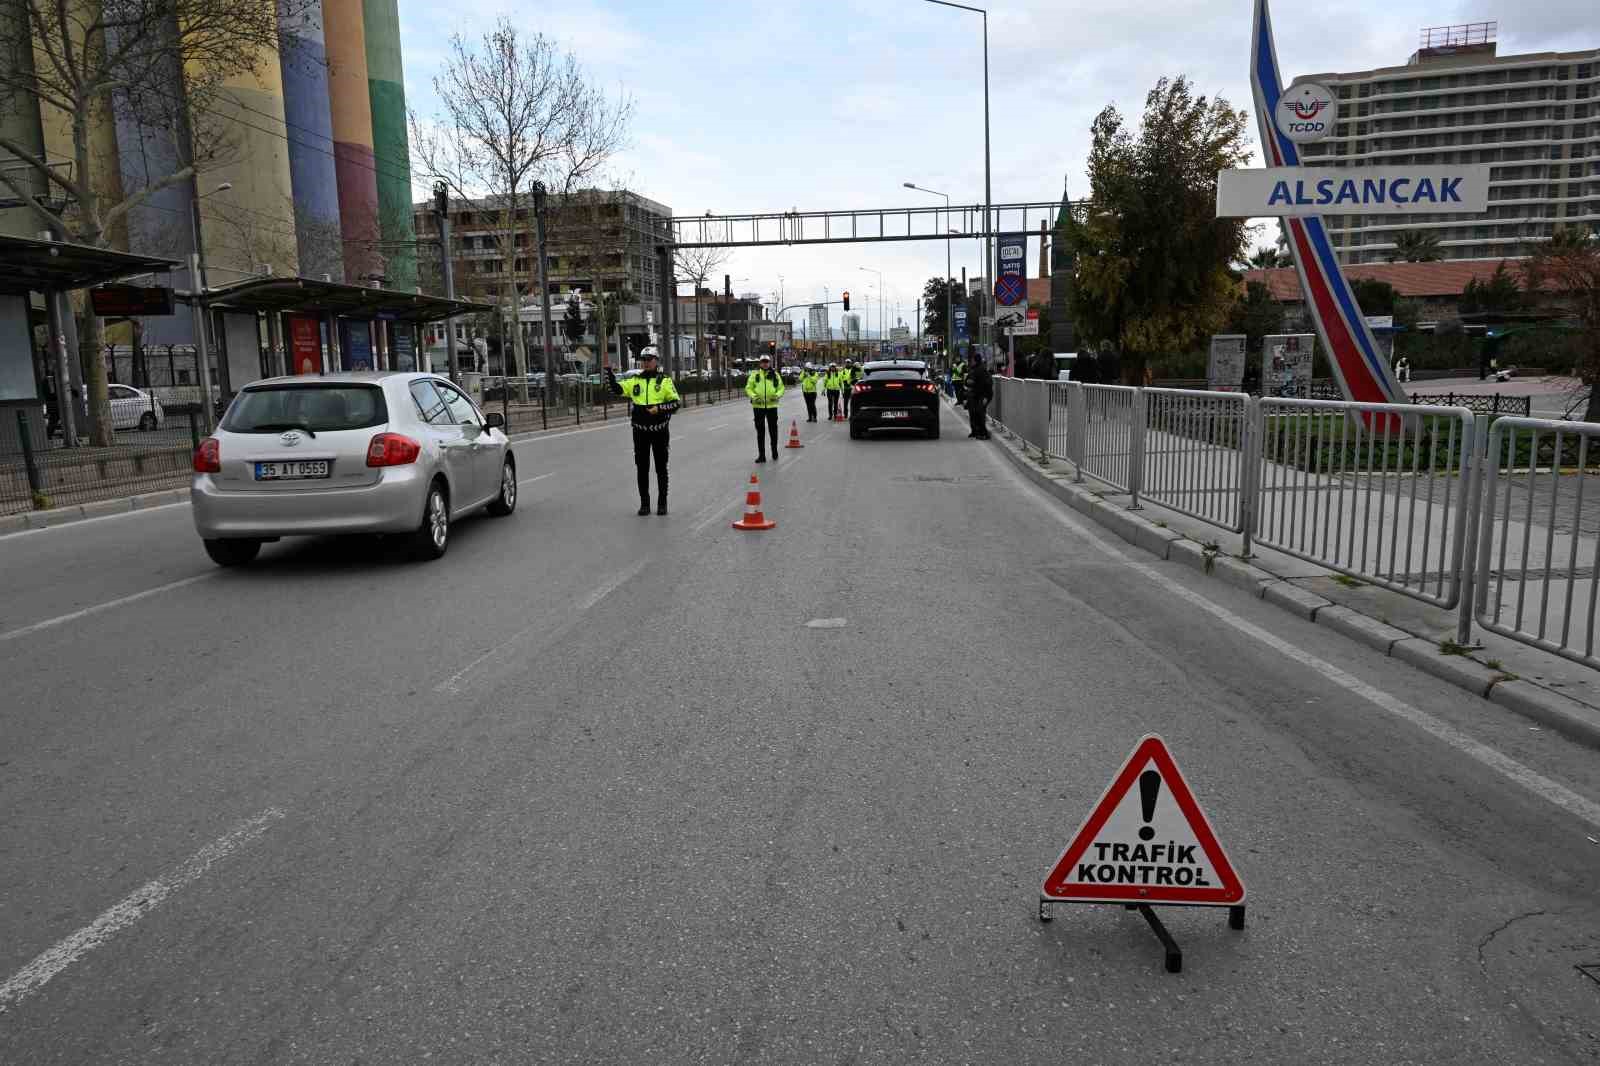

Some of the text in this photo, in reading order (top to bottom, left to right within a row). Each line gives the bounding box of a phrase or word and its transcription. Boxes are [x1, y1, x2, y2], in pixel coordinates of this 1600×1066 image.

[1288, 122, 1325, 133] TCDD
[1267, 177, 1464, 206] ALSANCAK
[263, 462, 326, 476] 35 AT 0569
[1094, 840, 1196, 864] TRAFİK
[1077, 863, 1210, 887] KONTROL
